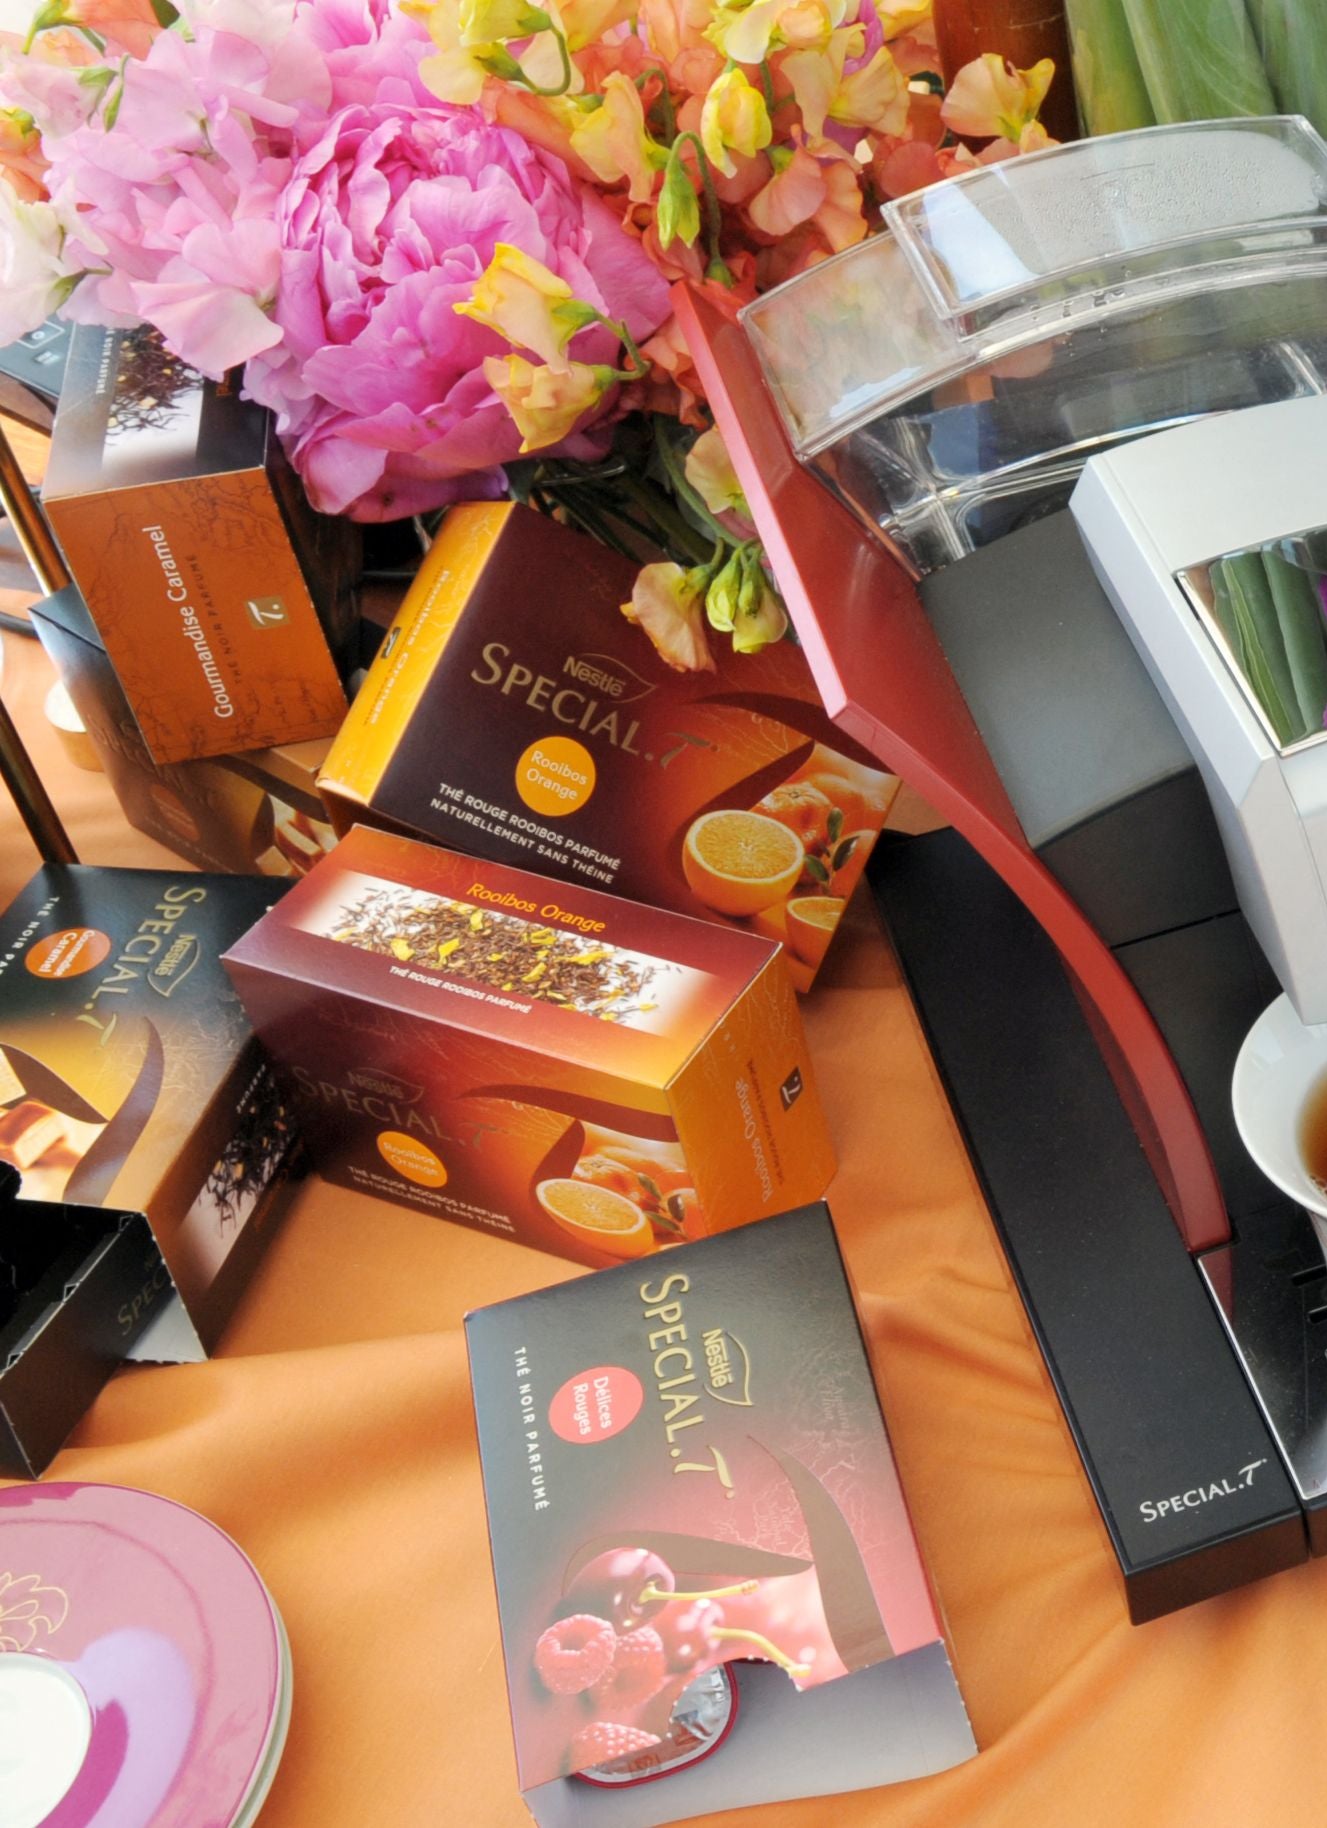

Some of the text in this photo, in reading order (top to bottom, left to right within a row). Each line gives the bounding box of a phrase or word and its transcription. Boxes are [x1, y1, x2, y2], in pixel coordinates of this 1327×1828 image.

[142, 525, 234, 718] Gourmandise Caramel
[526, 768, 578, 800] Orange
[531, 750, 588, 786] Rooibos
[430, 798, 614, 885] NATURELLEMENT SANS THÉINE
[439, 782, 621, 871] THÉ ROUGE ROOIBOS PARFUMÉ
[12, 921, 40, 950] NOIR
[466, 882, 607, 935] Rooibos Orange
[408, 970, 442, 990] ROUGE
[442, 981, 487, 1003] ROOIBOS
[701, 1328, 735, 1389] Nestlé
[514, 1346, 551, 1511] THÉ NOIR PARFUMÉ
[573, 1382, 592, 1436] Rouges
[593, 1376, 612, 1430] Délices
